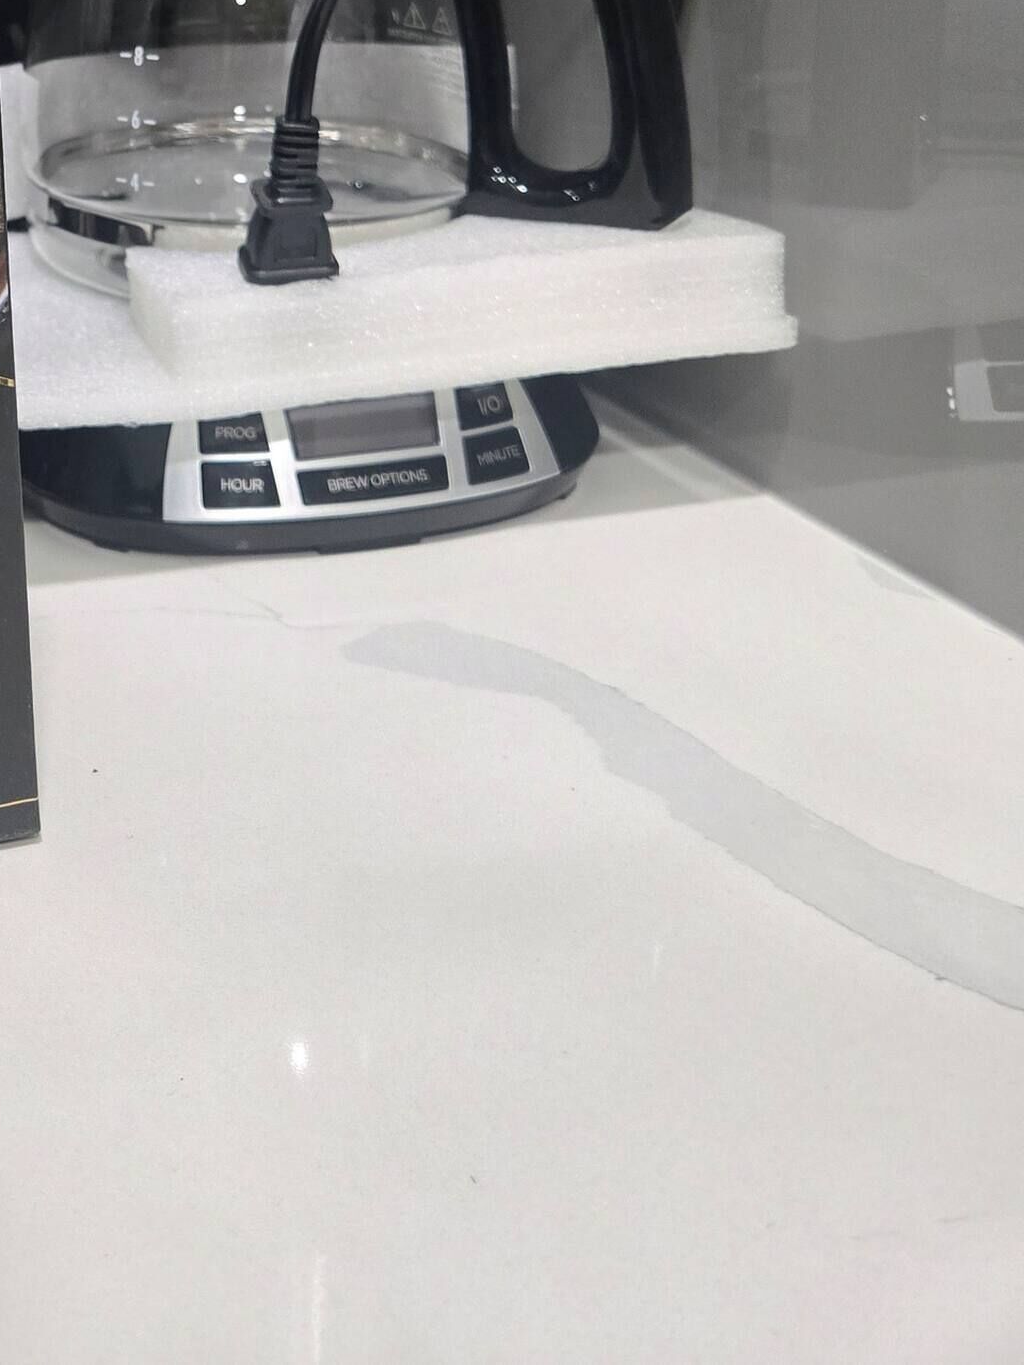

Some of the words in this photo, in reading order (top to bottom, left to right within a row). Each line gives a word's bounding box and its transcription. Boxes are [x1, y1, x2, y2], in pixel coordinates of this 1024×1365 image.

[133, 46, 144, 67] 8
[131, 109, 140, 129] 6
[476, 443, 521, 466] MINUTE
[220, 477, 265, 494] HOUR
[327, 474, 369, 493] BREW
[369, 468, 429, 486] OPTIONS
